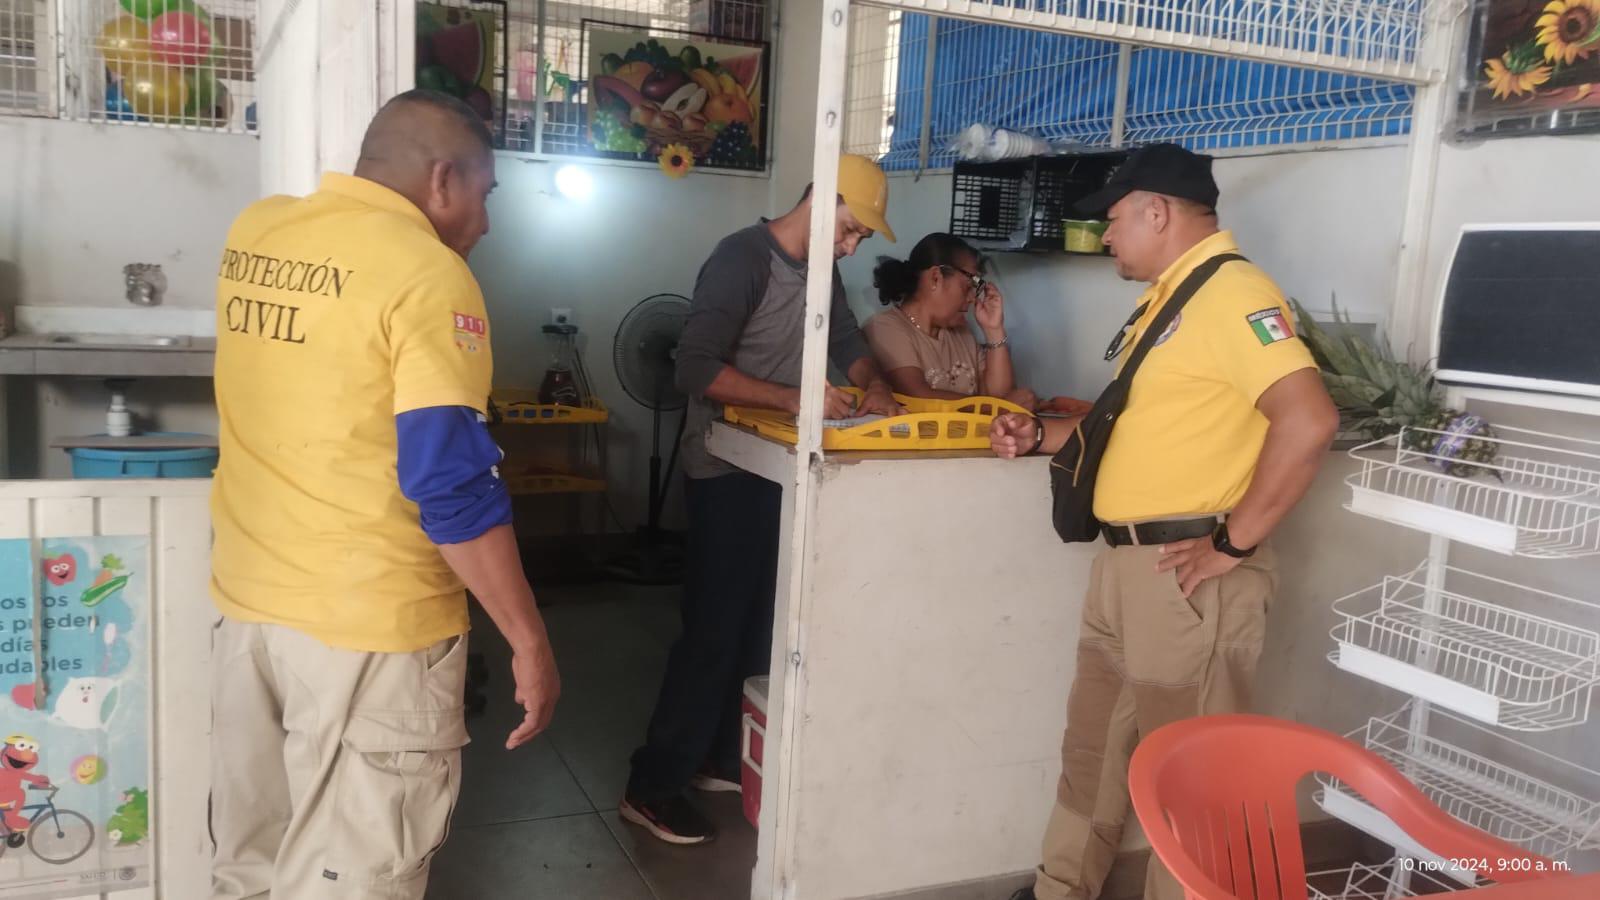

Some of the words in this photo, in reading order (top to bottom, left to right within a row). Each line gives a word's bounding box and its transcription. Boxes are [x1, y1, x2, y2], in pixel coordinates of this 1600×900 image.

[218, 248, 355, 299] PROTECCIÓN
[226, 296, 306, 344] CIVIL
[455, 314, 484, 333] 911
[41, 595, 69, 608] os
[1, 636, 49, 653] días
[0, 656, 82, 674] dales
